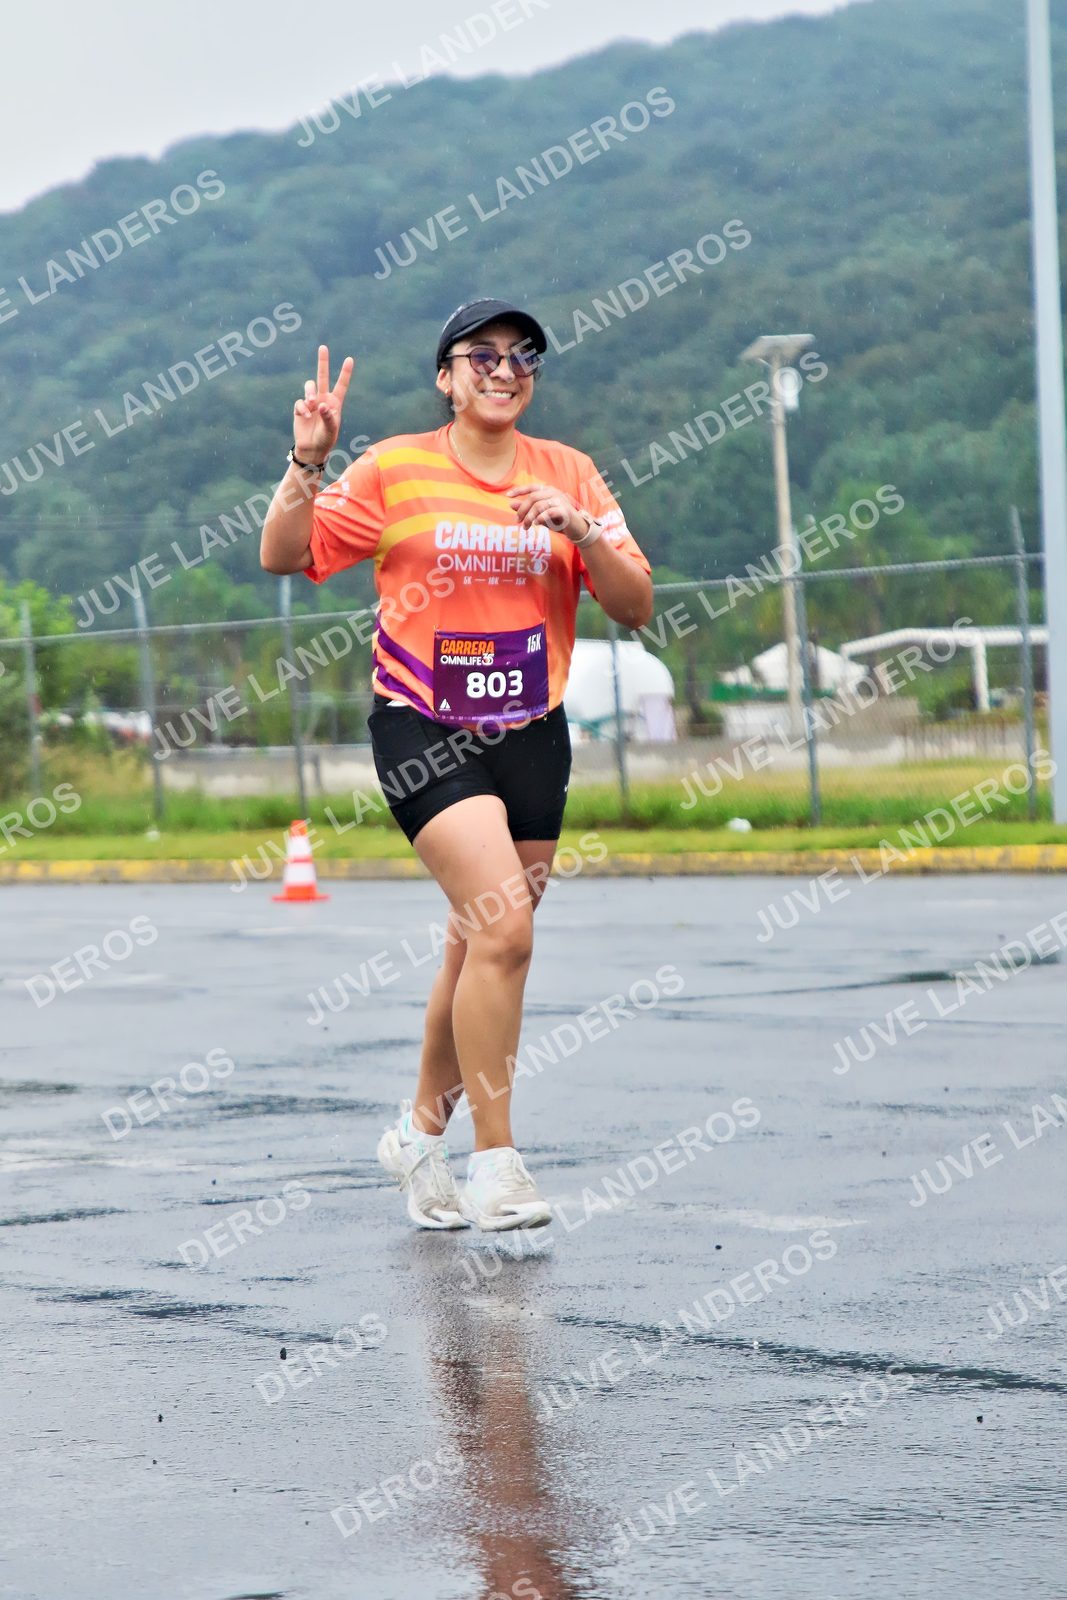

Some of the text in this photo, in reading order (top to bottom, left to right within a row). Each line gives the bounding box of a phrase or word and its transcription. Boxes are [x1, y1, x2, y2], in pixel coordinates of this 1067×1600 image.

[435, 520, 551, 553] CARRERA
[437, 553, 526, 574] OMNILIFE
[440, 639, 495, 656] CARRERA
[527, 632, 542, 654] 15K
[440, 655, 482, 666] OMNILIFE
[466, 670, 523, 698] 803
